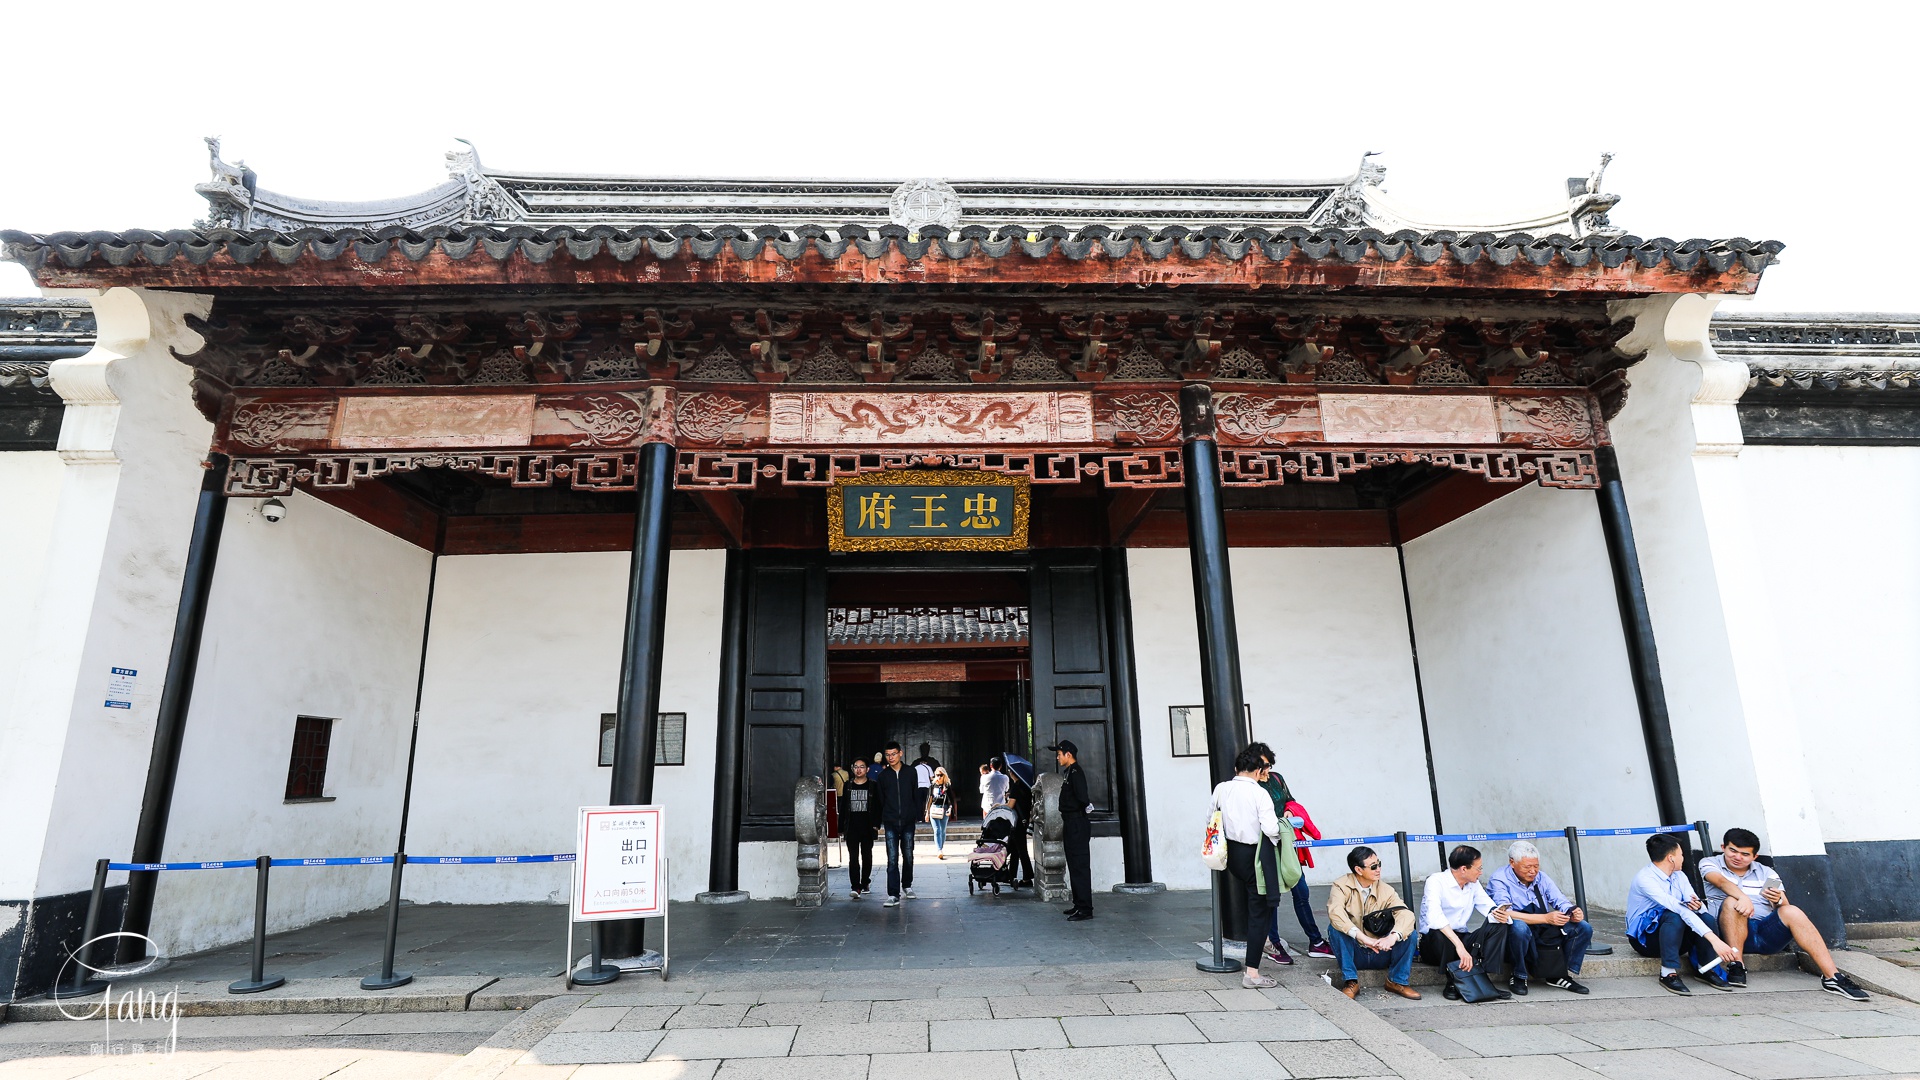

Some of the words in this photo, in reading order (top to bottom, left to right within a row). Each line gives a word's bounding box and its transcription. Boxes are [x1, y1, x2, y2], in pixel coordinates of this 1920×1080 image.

[621, 838, 647, 852] 出口
[621, 855, 646, 865] EXIT
[594, 887, 647, 898] 入口向前50米
